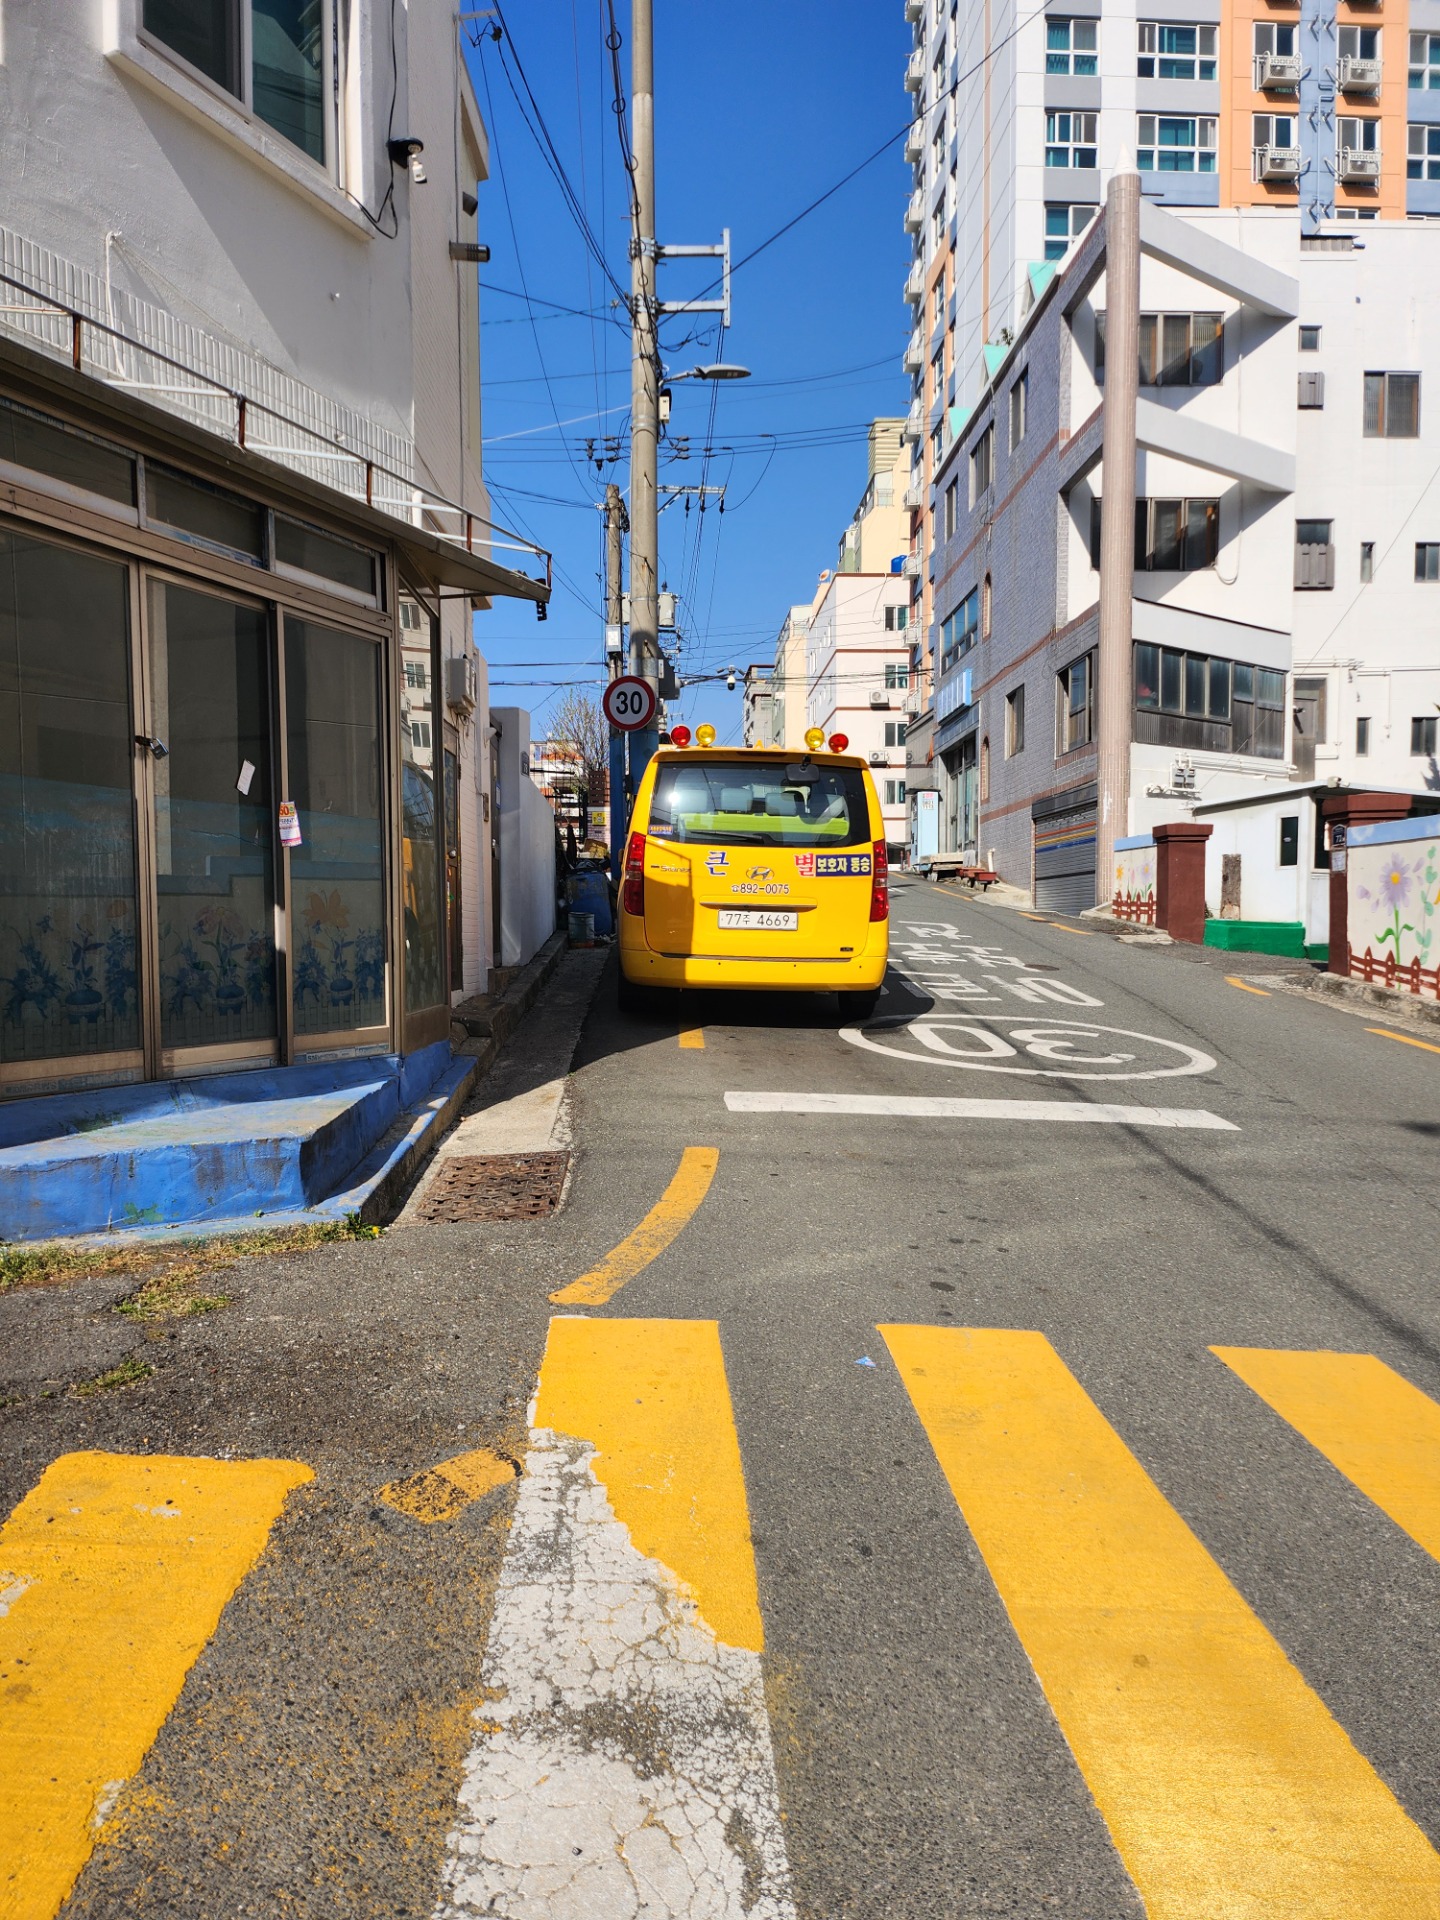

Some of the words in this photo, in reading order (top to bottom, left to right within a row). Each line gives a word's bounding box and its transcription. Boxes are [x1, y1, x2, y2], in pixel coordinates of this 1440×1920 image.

[615, 690, 643, 715] 30
[704, 850, 730, 876] 큰
[794, 852, 815, 877] 별
[816, 856, 848, 874] 보호자
[850, 856, 872, 873] 동승
[740, 882, 790, 895] 892-0075
[725, 913, 750, 926] 77주
[756, 913, 790, 926] 4669
